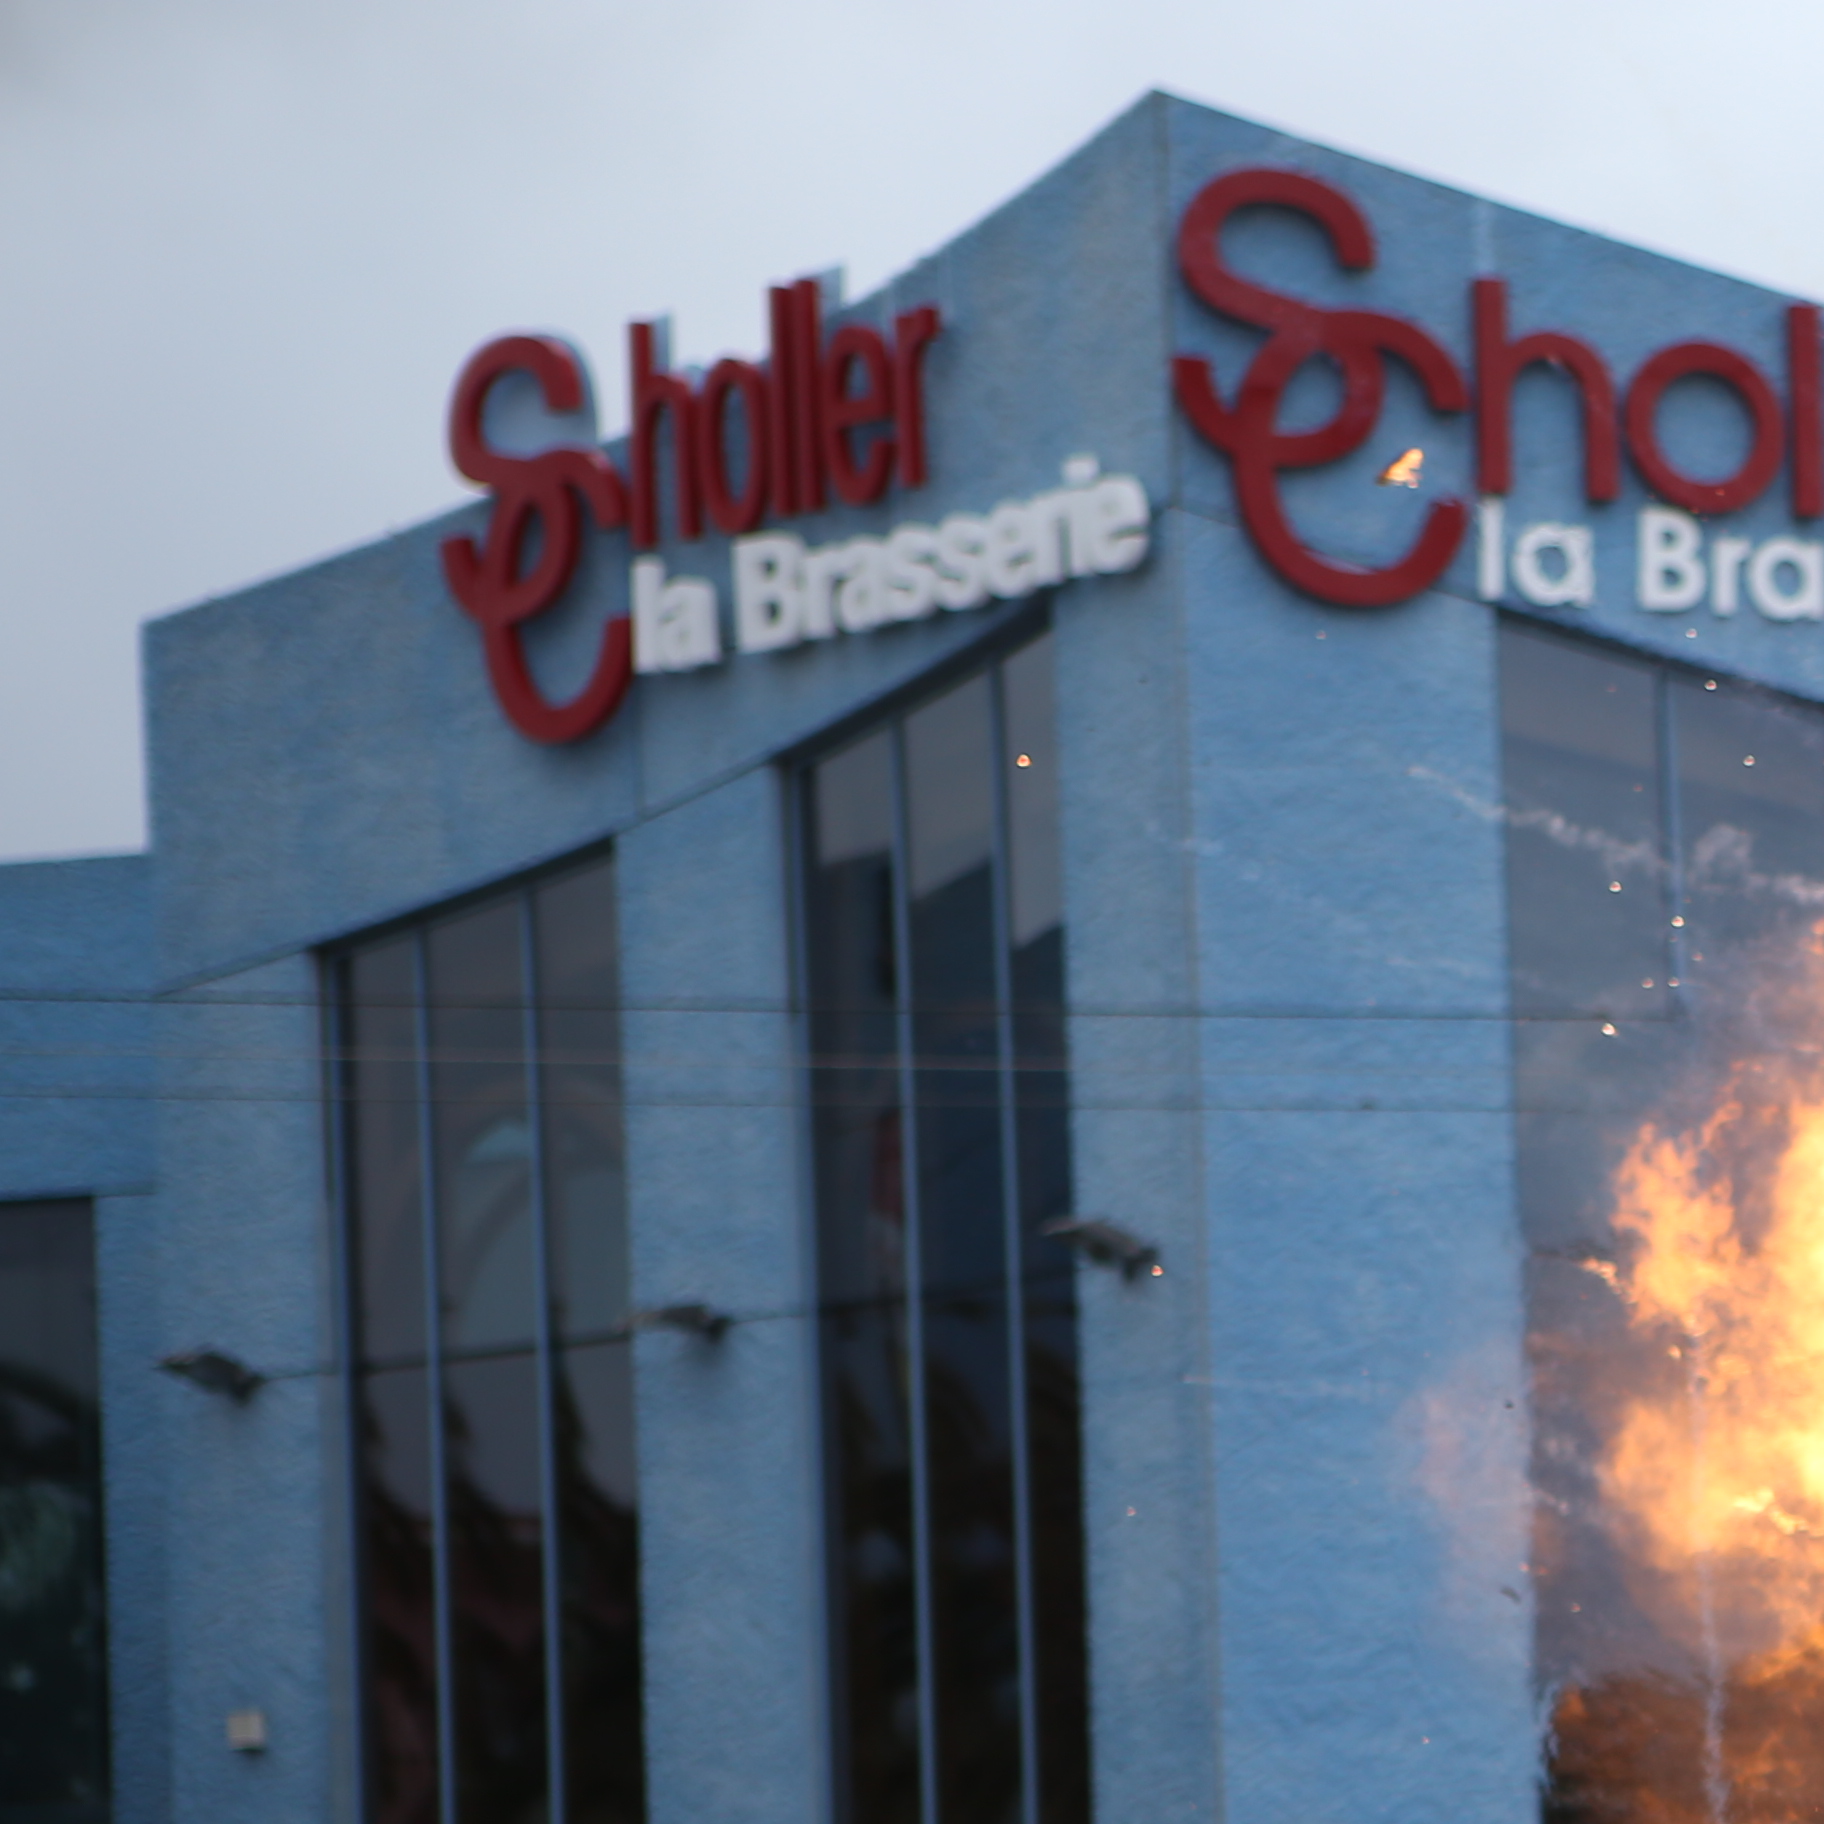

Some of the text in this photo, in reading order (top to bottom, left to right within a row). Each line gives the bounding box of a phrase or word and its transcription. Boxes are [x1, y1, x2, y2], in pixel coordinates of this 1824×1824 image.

[629, 453, 1152, 676] la Brasserie
[1475, 499, 1595, 609] la
